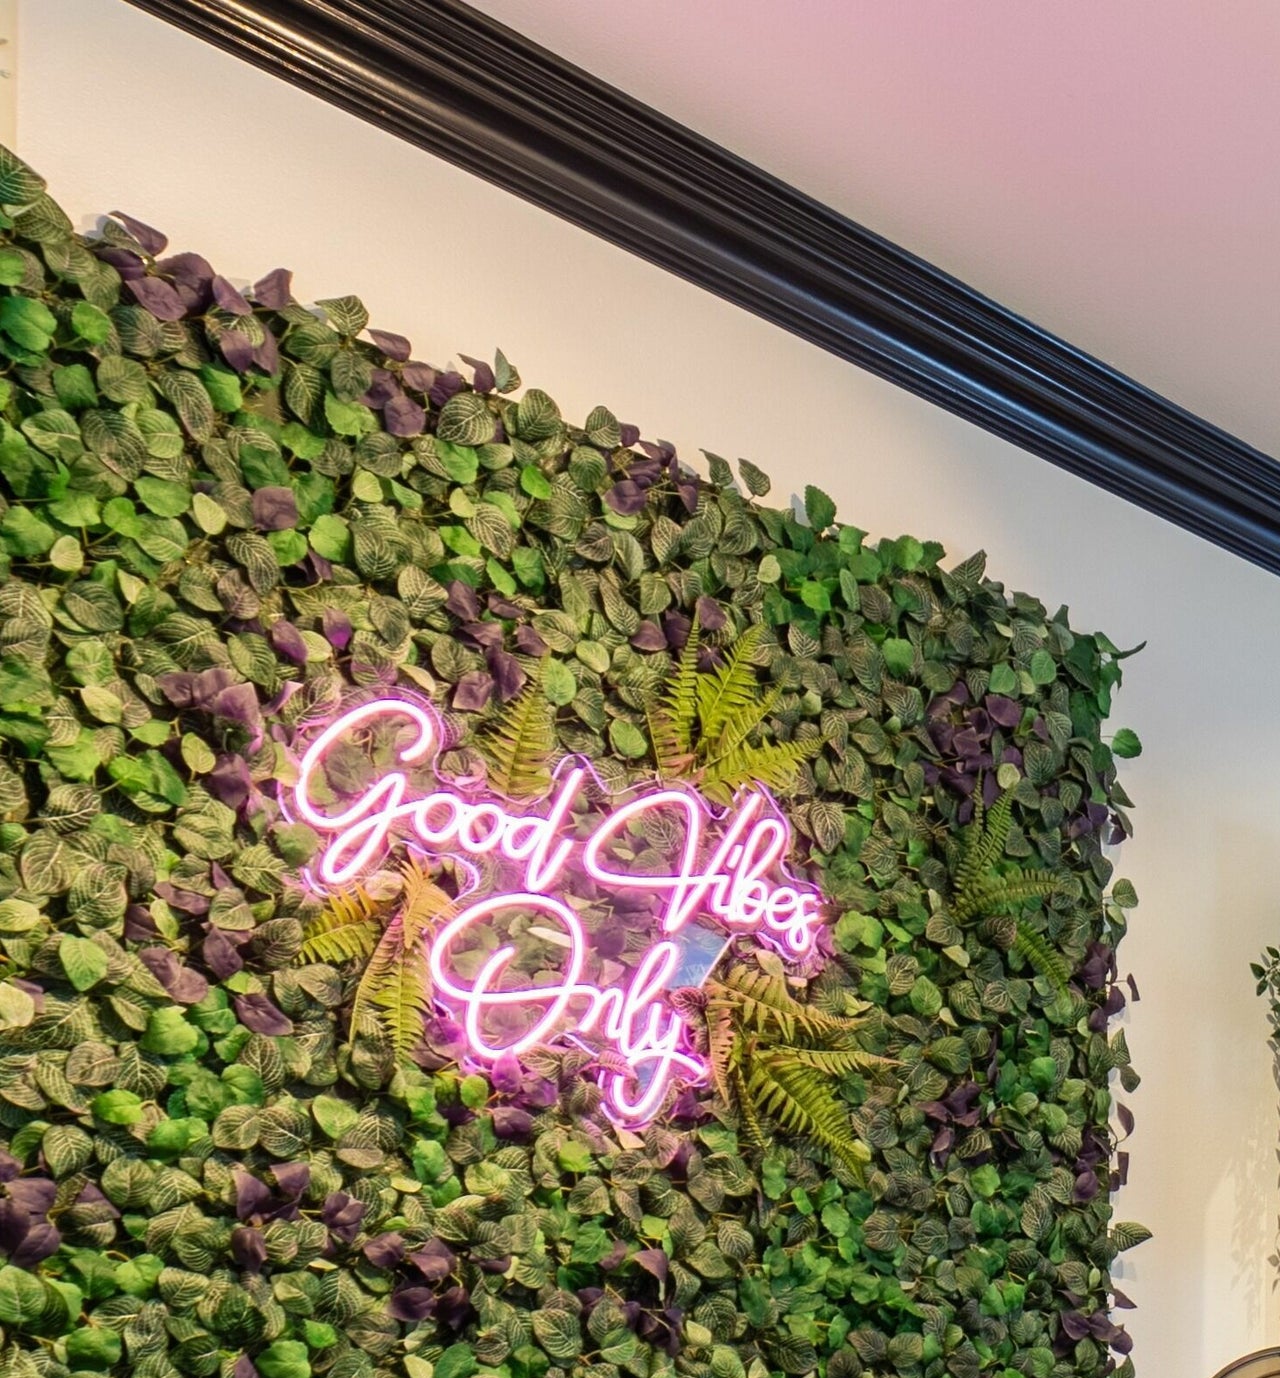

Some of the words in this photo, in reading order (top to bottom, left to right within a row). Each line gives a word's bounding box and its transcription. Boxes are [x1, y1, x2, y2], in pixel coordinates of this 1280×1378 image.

[294, 699, 574, 891] Good
[584, 791, 821, 951] Vibes
[431, 893, 705, 1118] Only
